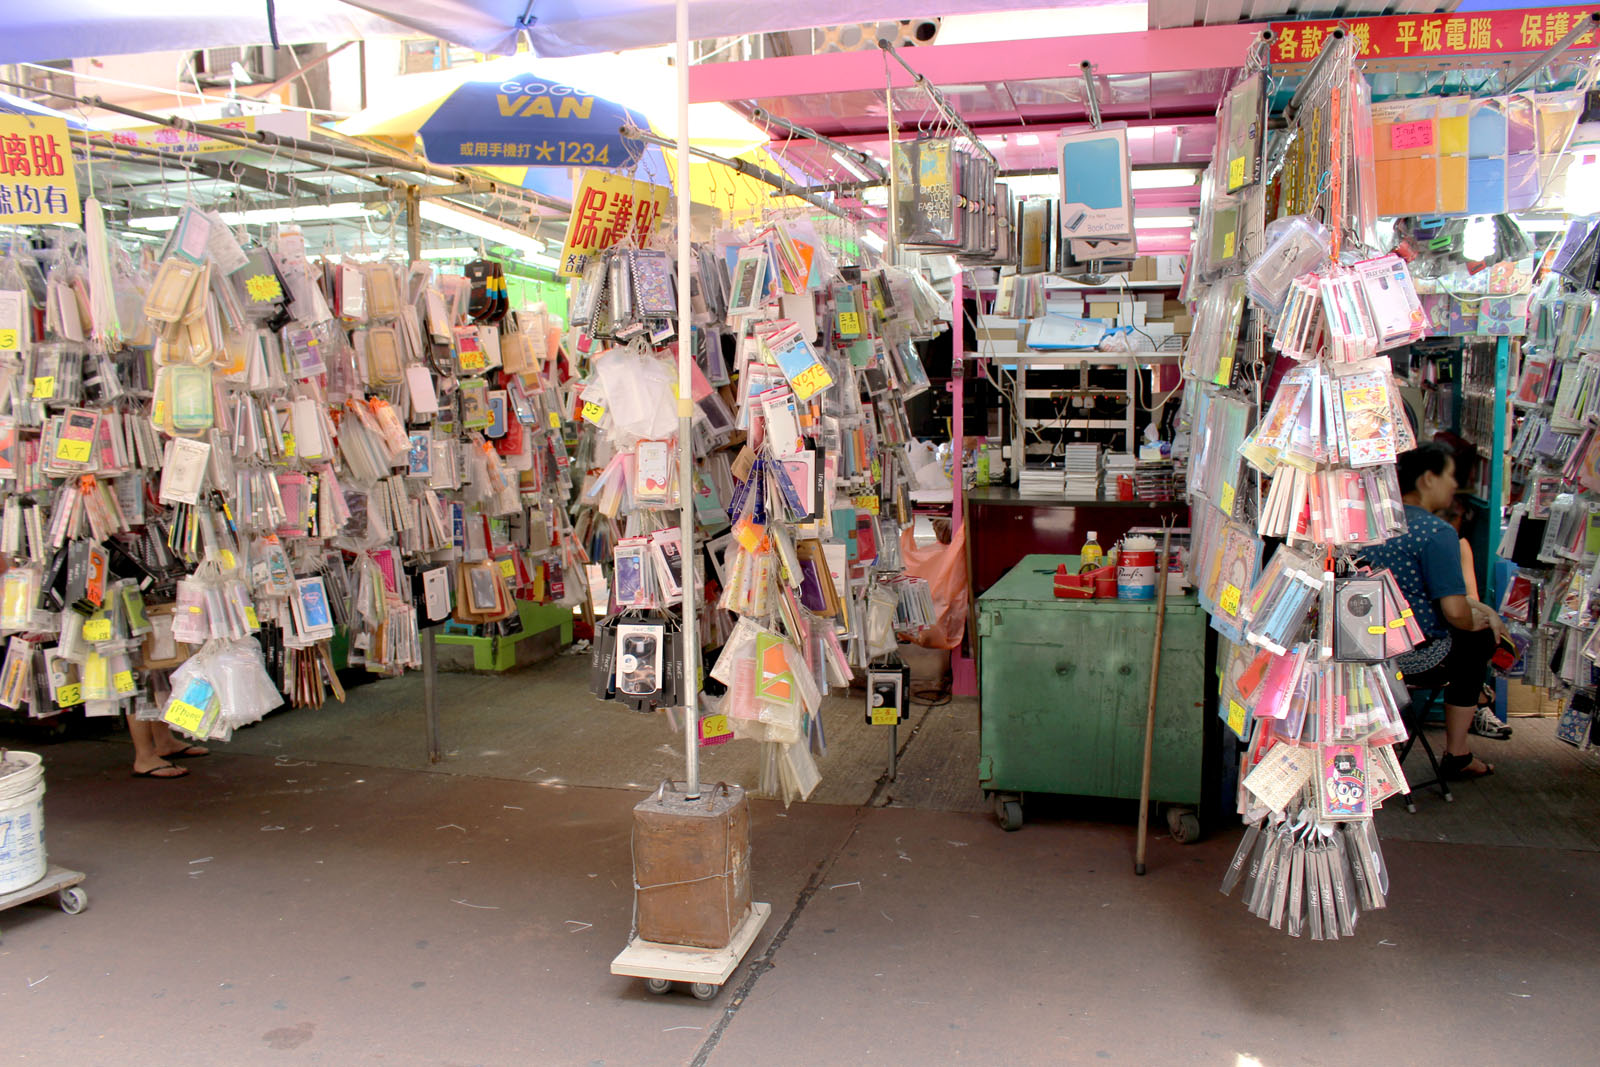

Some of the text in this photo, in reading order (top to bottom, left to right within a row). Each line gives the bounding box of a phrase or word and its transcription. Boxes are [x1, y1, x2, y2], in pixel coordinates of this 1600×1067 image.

[496, 94, 595, 119] VAN
[460, 141, 532, 159] 或用手機打
[920, 183, 951, 194] CHOOSE
[930, 192, 950, 203] YOUR
[918, 202, 951, 211] FASHION
[927, 211, 950, 220] STYLE
[1087, 223, 1125, 232] Book Cover
[791, 364, 825, 390] NOTE
[806, 381, 822, 395] 2
[705, 720, 724, 735] S6
